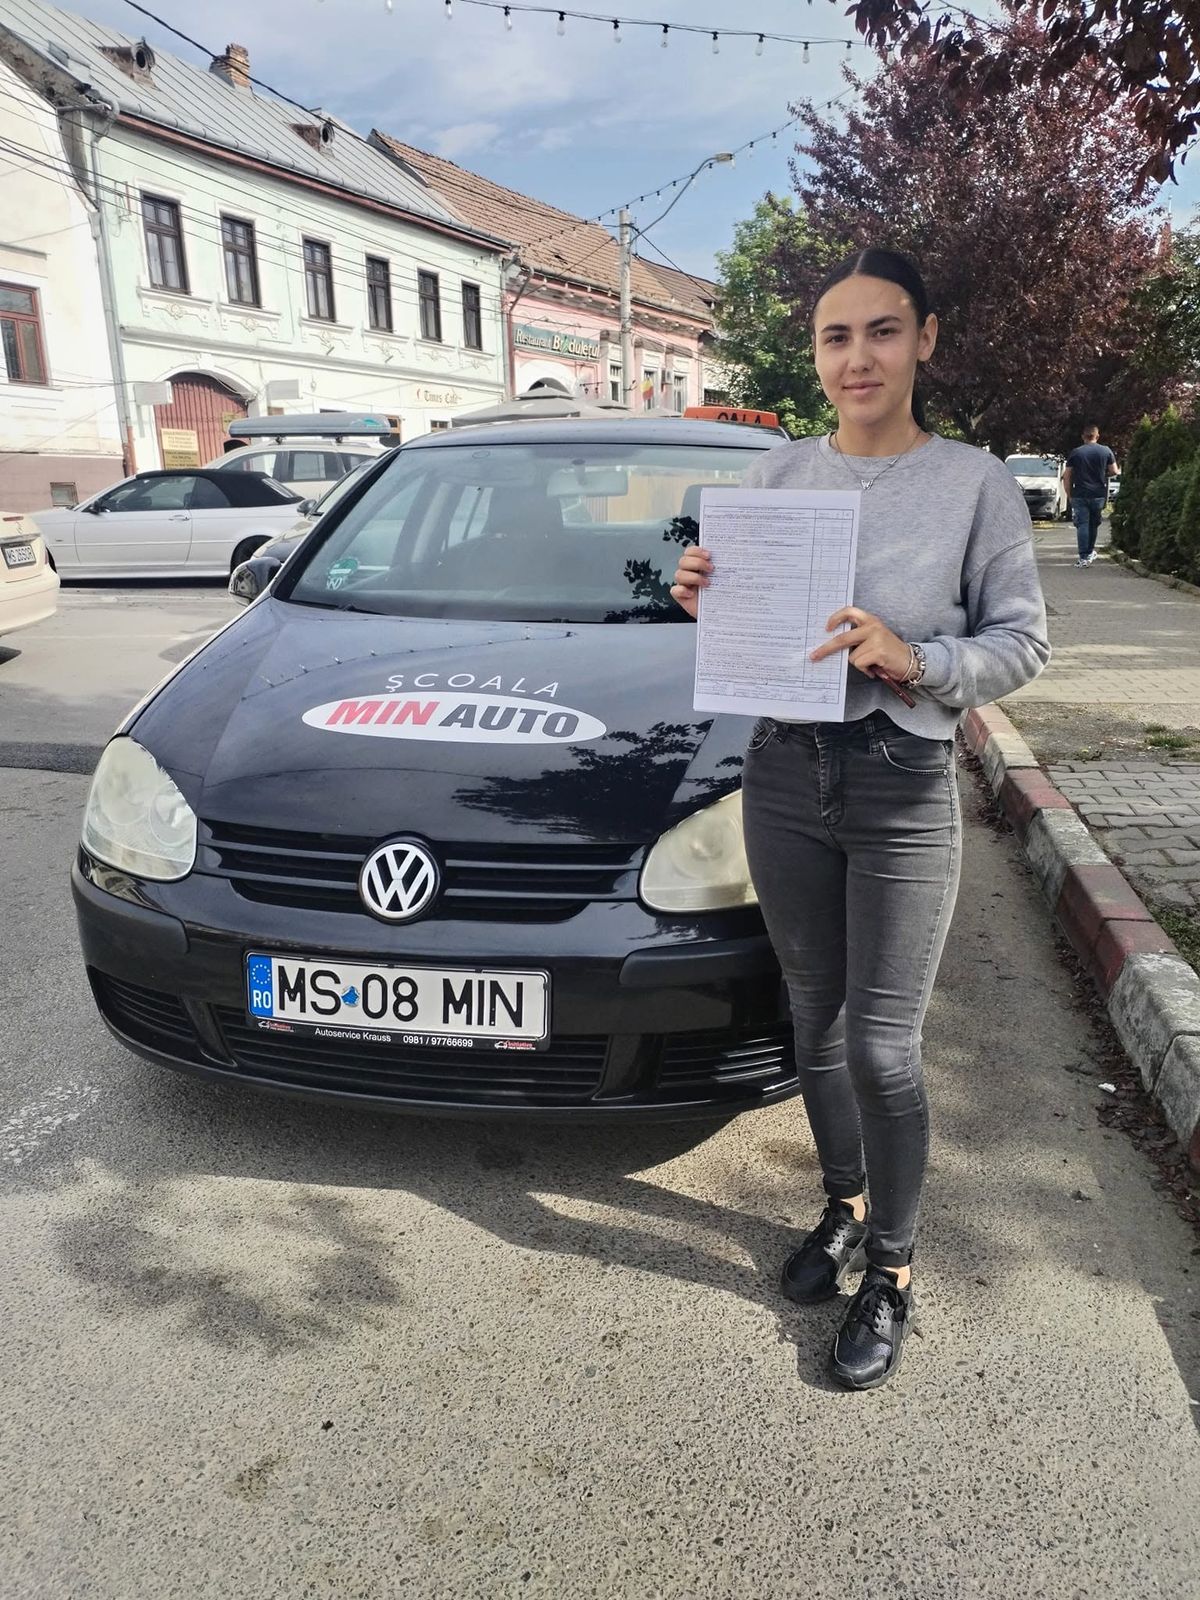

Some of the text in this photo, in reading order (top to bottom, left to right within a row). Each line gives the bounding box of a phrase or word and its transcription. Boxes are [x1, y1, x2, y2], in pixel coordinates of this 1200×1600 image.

[325, 700, 579, 737] MIN AUTO
[252, 989, 272, 1009] RO
[278, 965, 524, 1028] MS 08 MIN
[314, 1027, 392, 1042] Autoservice Krauss
[403, 1036, 424, 1045] 0981
[431, 1037, 474, 1048] 97766699
